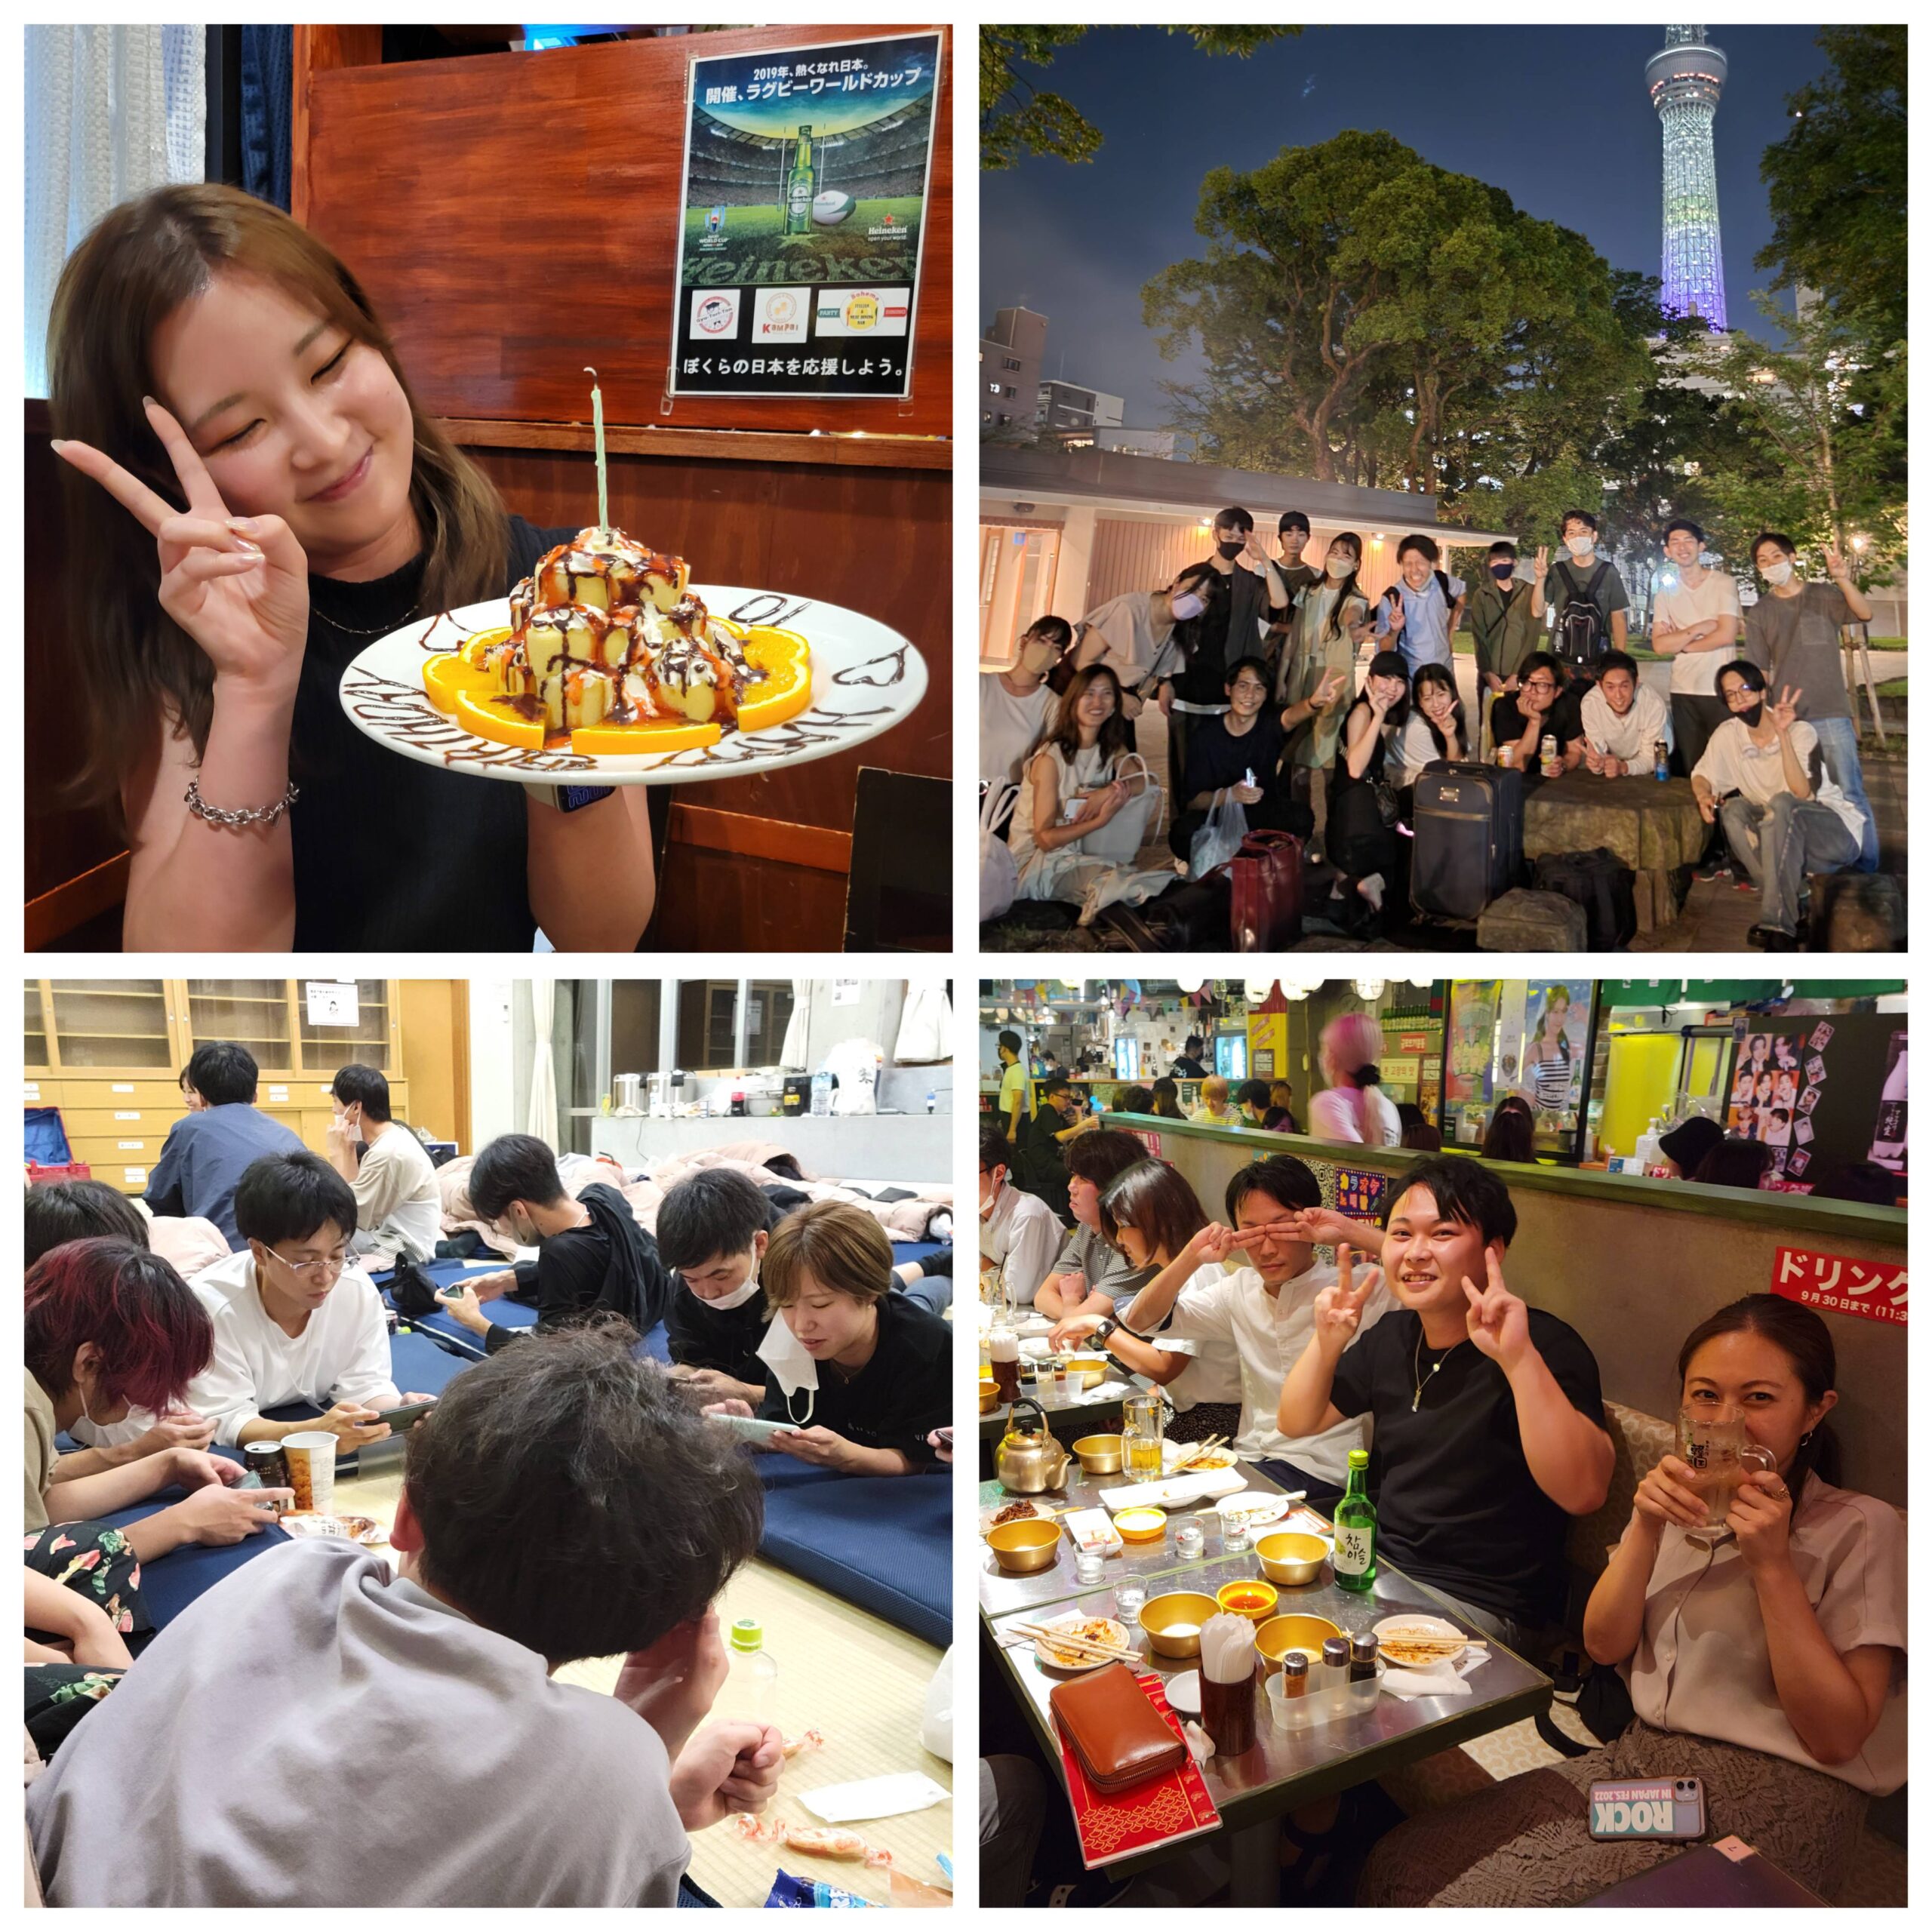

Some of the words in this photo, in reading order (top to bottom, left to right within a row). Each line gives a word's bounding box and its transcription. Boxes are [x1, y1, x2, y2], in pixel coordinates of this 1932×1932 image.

[753, 59, 868, 81] 2019年、熱くなれ日本。
[706, 67, 921, 105] 開催、ラグビーワールドカップ
[868, 226, 907, 235] Heineken
[683, 358, 903, 377] ぼくらの日本を応援しよう。
[1347, 1548, 1367, 1565] 이슬
[1631, 1789, 1660, 1800] JAPAN
[1661, 1788, 1672, 1798] IN
[1594, 1801, 1674, 1833] ROCK
